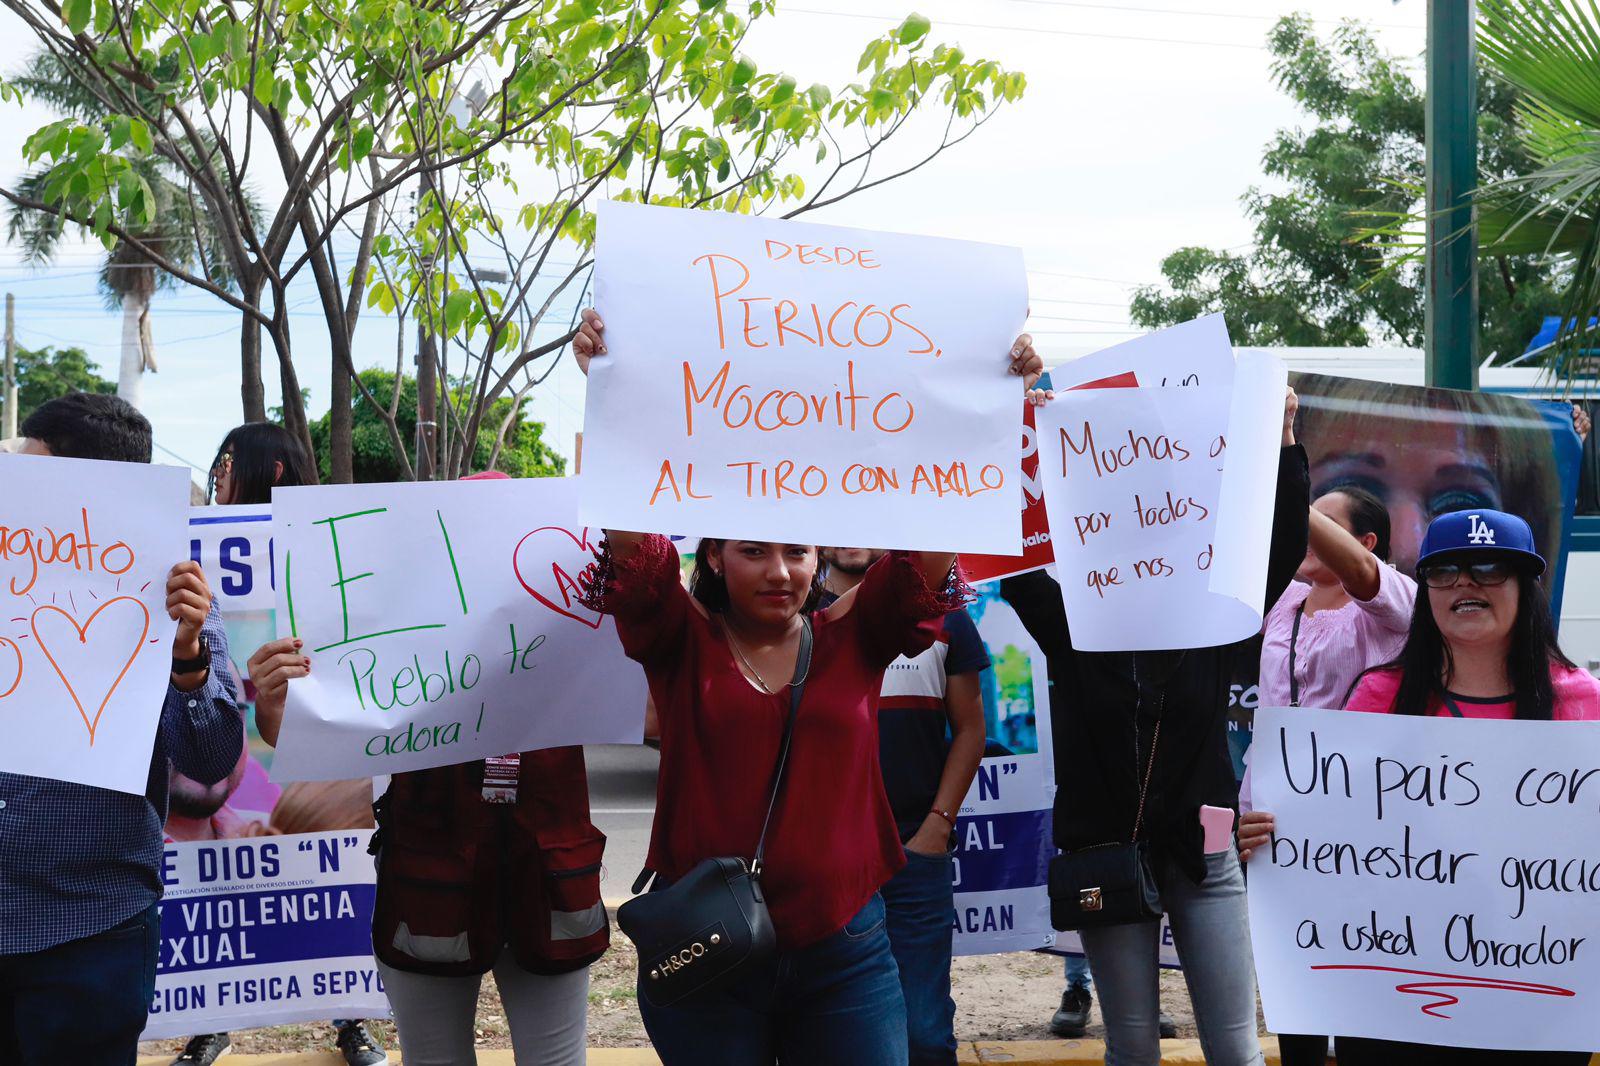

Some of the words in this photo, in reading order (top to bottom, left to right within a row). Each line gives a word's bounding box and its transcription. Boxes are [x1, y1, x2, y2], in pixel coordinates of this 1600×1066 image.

[766, 239, 881, 269] DESDE
[682, 360, 914, 436] Mocorito
[1059, 421, 1190, 478] Muchas
[649, 460, 712, 506] AL
[727, 460, 828, 499] TIRO
[841, 464, 899, 494] CON
[1074, 512, 1111, 545] por
[1467, 514, 1496, 545] LA
[1087, 566, 1124, 598] que
[1133, 557, 1174, 578] nos
[337, 648, 481, 711] Pueblo
[503, 623, 546, 674] te
[1280, 727, 1352, 798] Un
[1376, 754, 1480, 820] pais
[197, 843, 280, 883] DIOS
[1269, 825, 1479, 885] bienestar
[182, 890, 355, 932] VIOLENCIA
[659, 942, 709, 977] H&CO.
[1296, 919, 1326, 949] a
[1342, 911, 1418, 956] usted
[1445, 913, 1586, 969] Obrador
[218, 975, 302, 1006] FISICA
